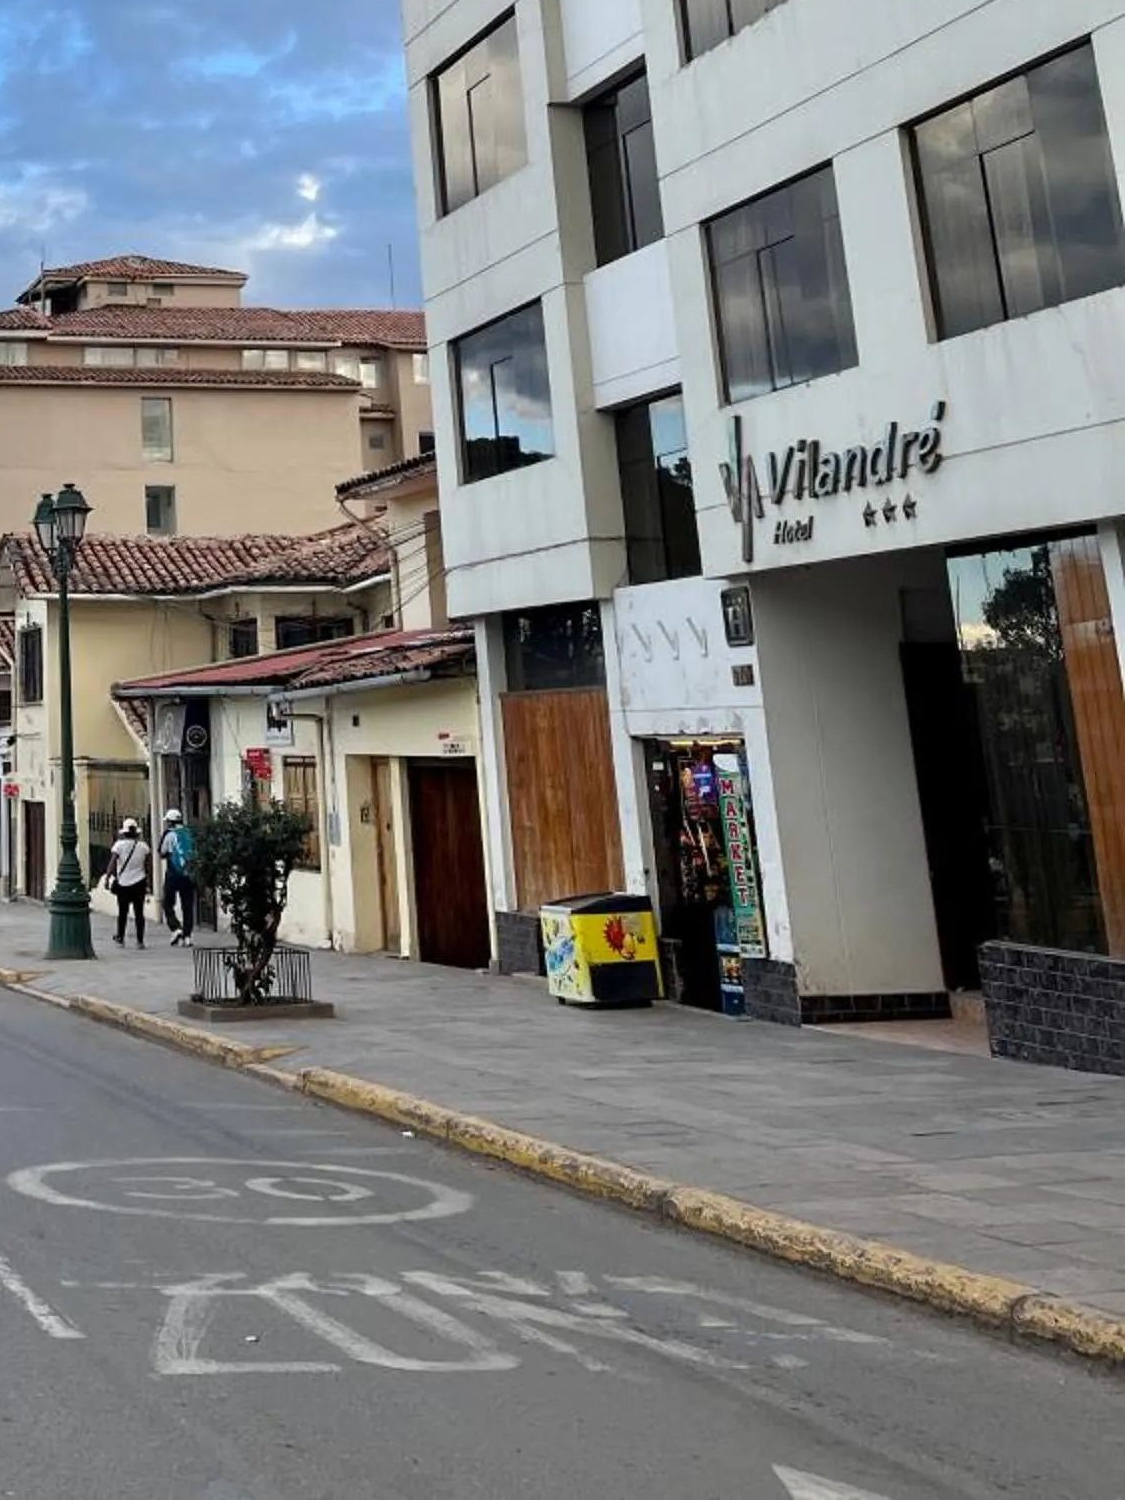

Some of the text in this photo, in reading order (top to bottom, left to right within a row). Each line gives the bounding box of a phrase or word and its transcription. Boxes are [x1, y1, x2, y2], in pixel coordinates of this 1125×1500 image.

[765, 401, 946, 505] Vilandré
[774, 515, 814, 545] Hotel
[720, 778, 749, 908] MARKET
[113, 1176, 373, 1201] 30
